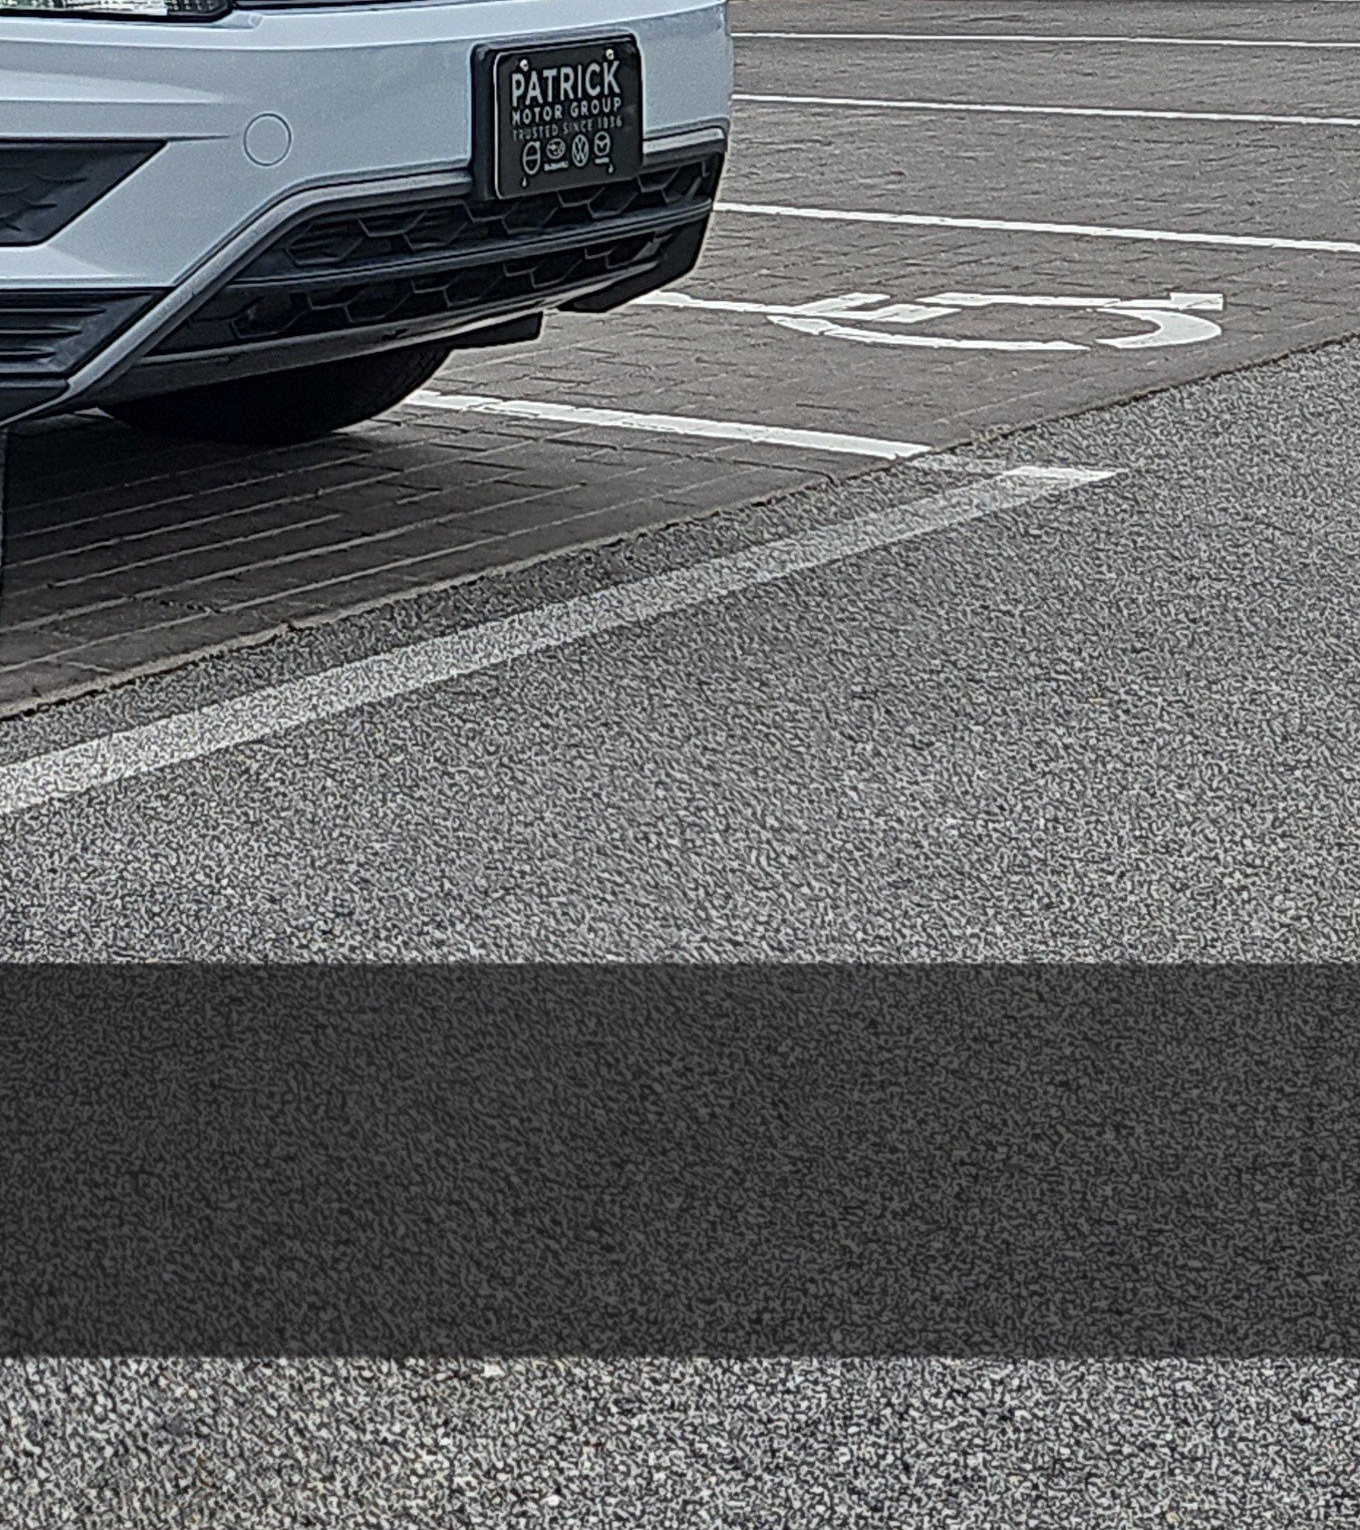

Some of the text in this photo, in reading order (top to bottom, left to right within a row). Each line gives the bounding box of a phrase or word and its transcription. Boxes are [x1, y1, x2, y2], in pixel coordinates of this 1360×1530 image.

[511, 60, 621, 106] PATRICK
[511, 97, 622, 126] MOTOR GROUP
[513, 124, 559, 141] TRUSTED
[563, 119, 593, 135] SINCE
